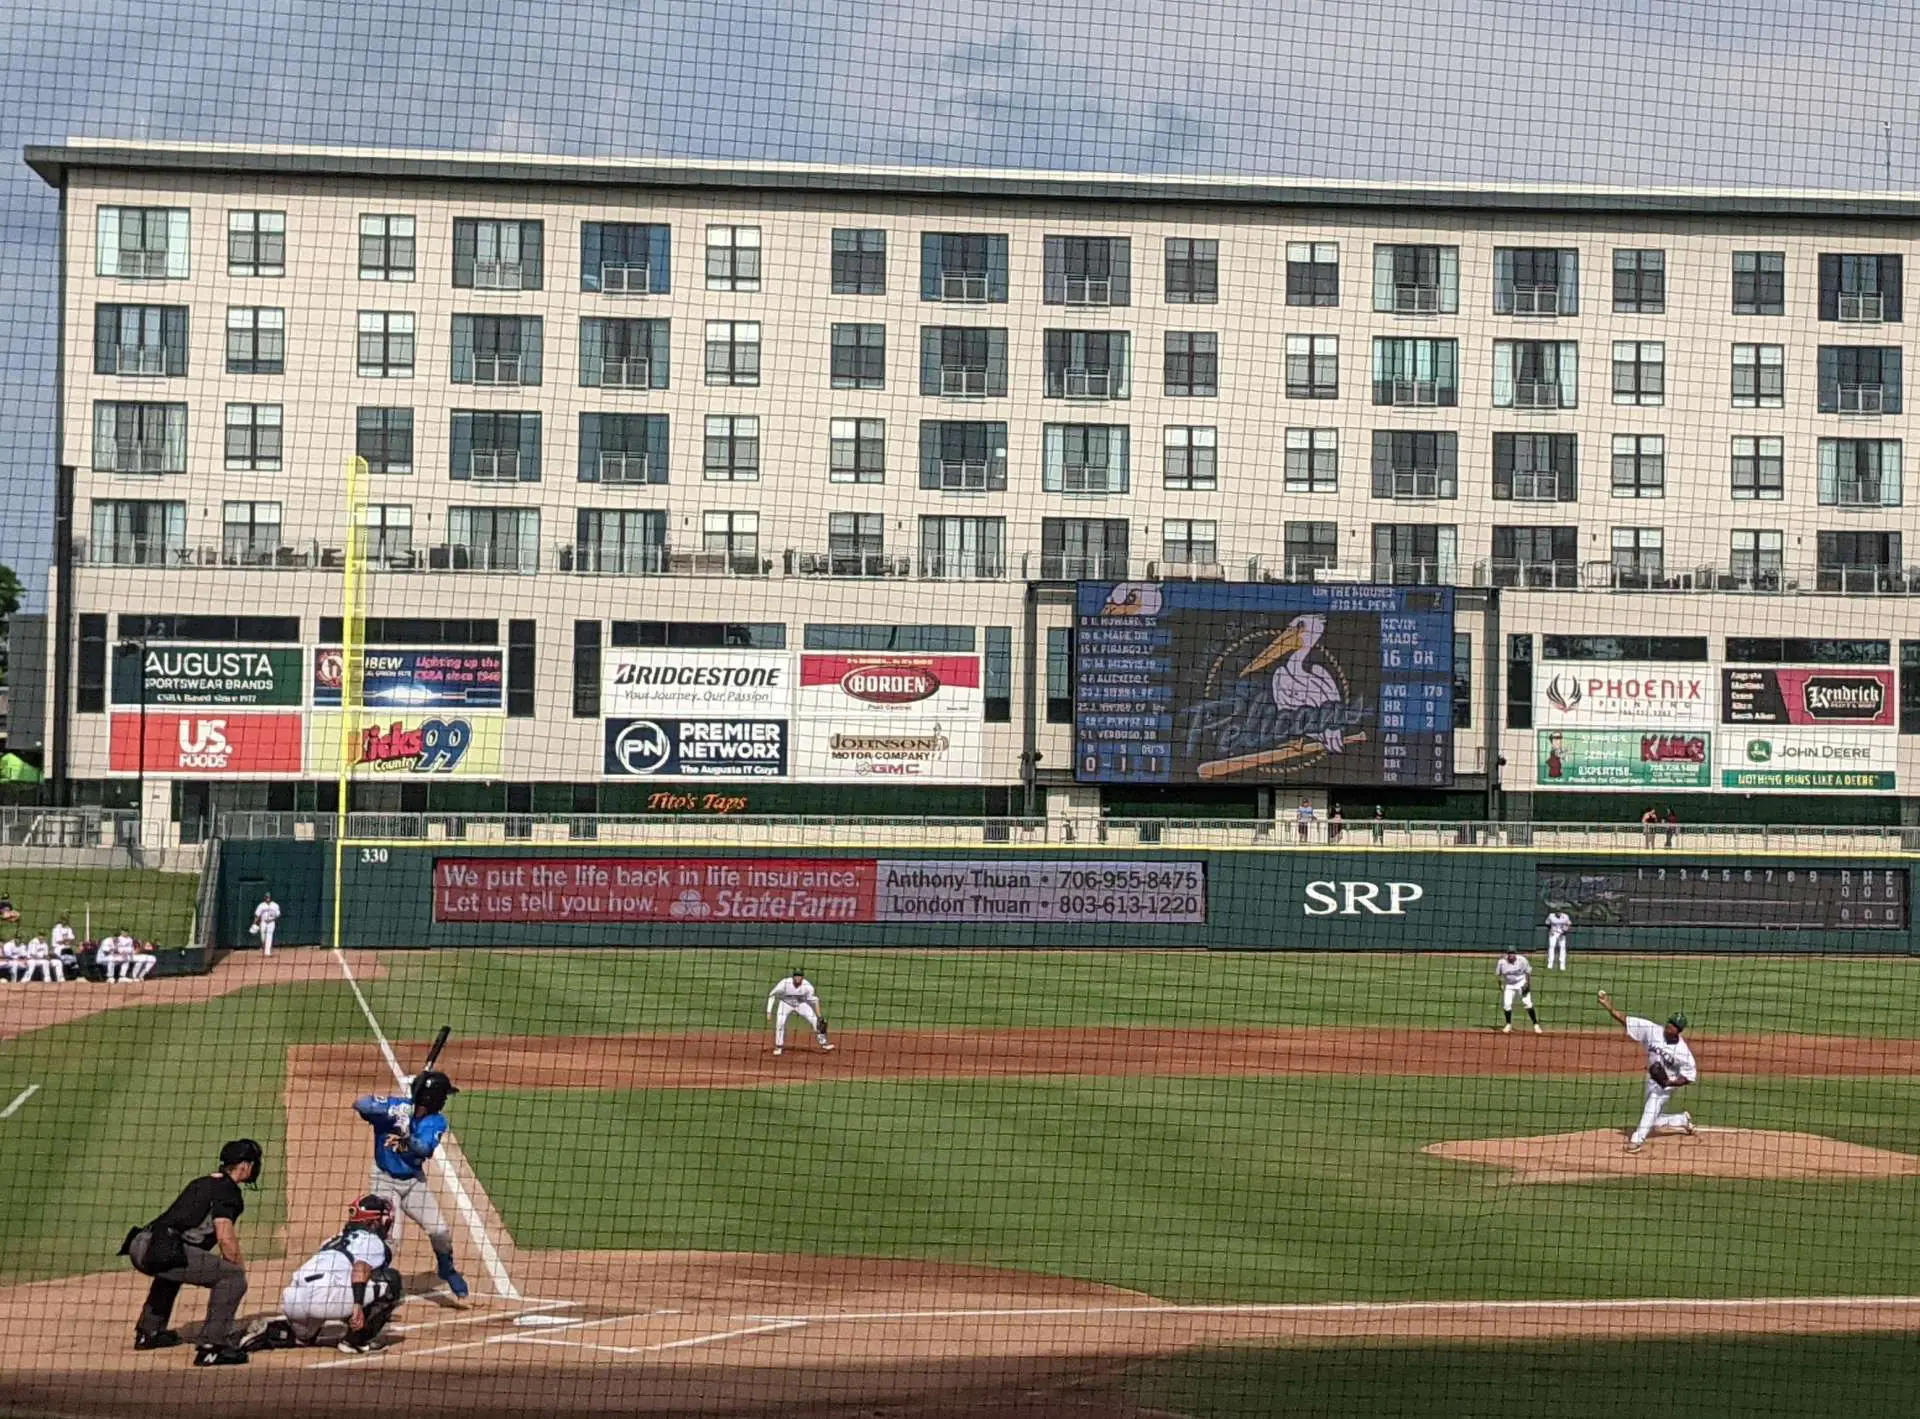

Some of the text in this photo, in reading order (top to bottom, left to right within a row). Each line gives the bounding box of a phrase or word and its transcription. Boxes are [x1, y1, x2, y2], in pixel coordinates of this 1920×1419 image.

[1381, 619, 1416, 630] KEVIN
[1381, 633, 1418, 644] MADE
[145, 651, 273, 676] AUGUSTA
[365, 656, 403, 670] IBEW
[464, 658, 478, 669] up
[1383, 649, 1434, 667] 16 DH
[614, 664, 781, 686] BRIDGESTONE
[225, 679, 273, 690] BRANDS
[854, 675, 926, 693] BORDEN
[1384, 685, 1406, 697] AVG
[1588, 679, 1701, 699] PHOENIX
[625, 690, 648, 700] Your
[1807, 685, 1879, 709] Kendrick
[1384, 701, 1434, 712] HR 0
[1384, 715, 1433, 728] RBI 2
[679, 722, 780, 741] PREMIER
[1435, 734, 1442, 743] 0
[418, 717, 472, 772] 99
[830, 733, 931, 750] JOHNSON
[623, 739, 664, 763] PN
[679, 742, 780, 759] NETWORX
[875, 752, 930, 760] COMPANY
[1435, 746, 1442, 756] 0
[1777, 746, 1870, 758] JOHN DEERE
[179, 753, 227, 767] FOODS
[374, 756, 420, 772] Country
[1086, 757, 1156, 772] 0 1 1
[1435, 760, 1442, 769] 0
[680, 765, 699, 774] The
[700, 765, 742, 775] Augusta
[753, 766, 779, 775] Guys
[872, 764, 920, 774] GMC
[1738, 774, 1782, 785] NOTHING
[1785, 775, 1811, 785] RUNS
[1812, 775, 1834, 785] LIKE
[1835, 775, 1843, 785] A
[648, 792, 748, 814] Tito's Taps
[361, 849, 388, 863] 330
[444, 865, 478, 886] We
[487, 866, 525, 890] put
[531, 866, 568, 886] the
[575, 865, 608, 886] life
[617, 866, 670, 887] back
[679, 866, 699, 886] in
[707, 865, 741, 886] life
[886, 870, 1198, 892] Anthony Thuan 706-955-8475
[1638, 869, 1893, 885] 1 2 3 4 5 6 7 8 9 R H E
[1303, 880, 1423, 915] SRP
[1842, 886, 1893, 898] 0 0 0
[444, 891, 658, 916] Let us tell you how.
[893, 896, 1197, 914] London Thuan 803-613-1220
[1841, 909, 1893, 921] 0 0 0
